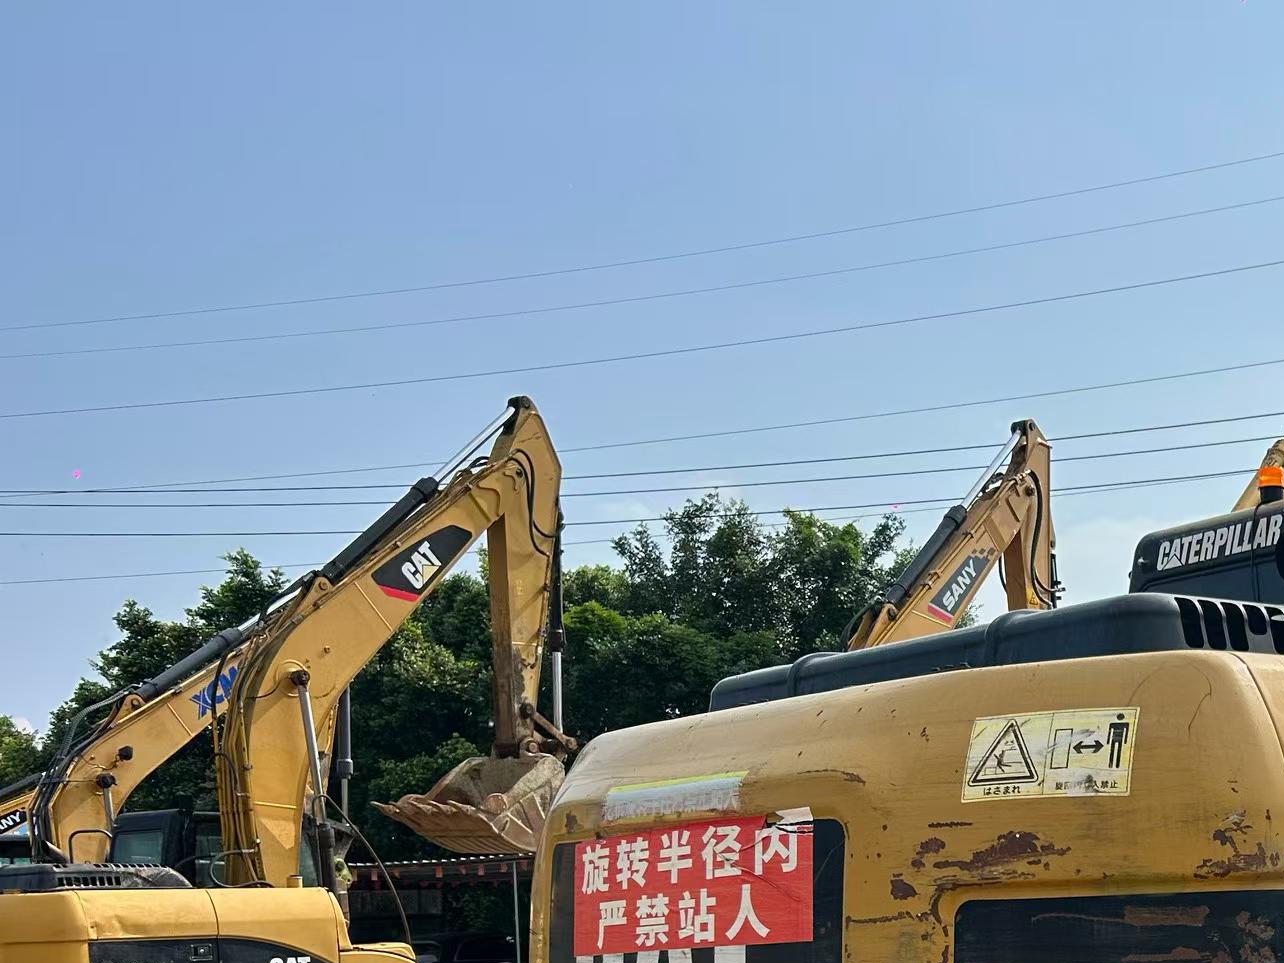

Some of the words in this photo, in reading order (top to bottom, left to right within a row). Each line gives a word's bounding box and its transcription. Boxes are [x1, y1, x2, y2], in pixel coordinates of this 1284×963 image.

[402, 541, 441, 589] CAT
[1157, 514, 1283, 571] CATERPILLAR
[943, 559, 977, 611] SANY
[984, 786, 1020, 796] はさまれ
[581, 825, 798, 895] 旋转半径内
[596, 884, 771, 950] 严禁站人
